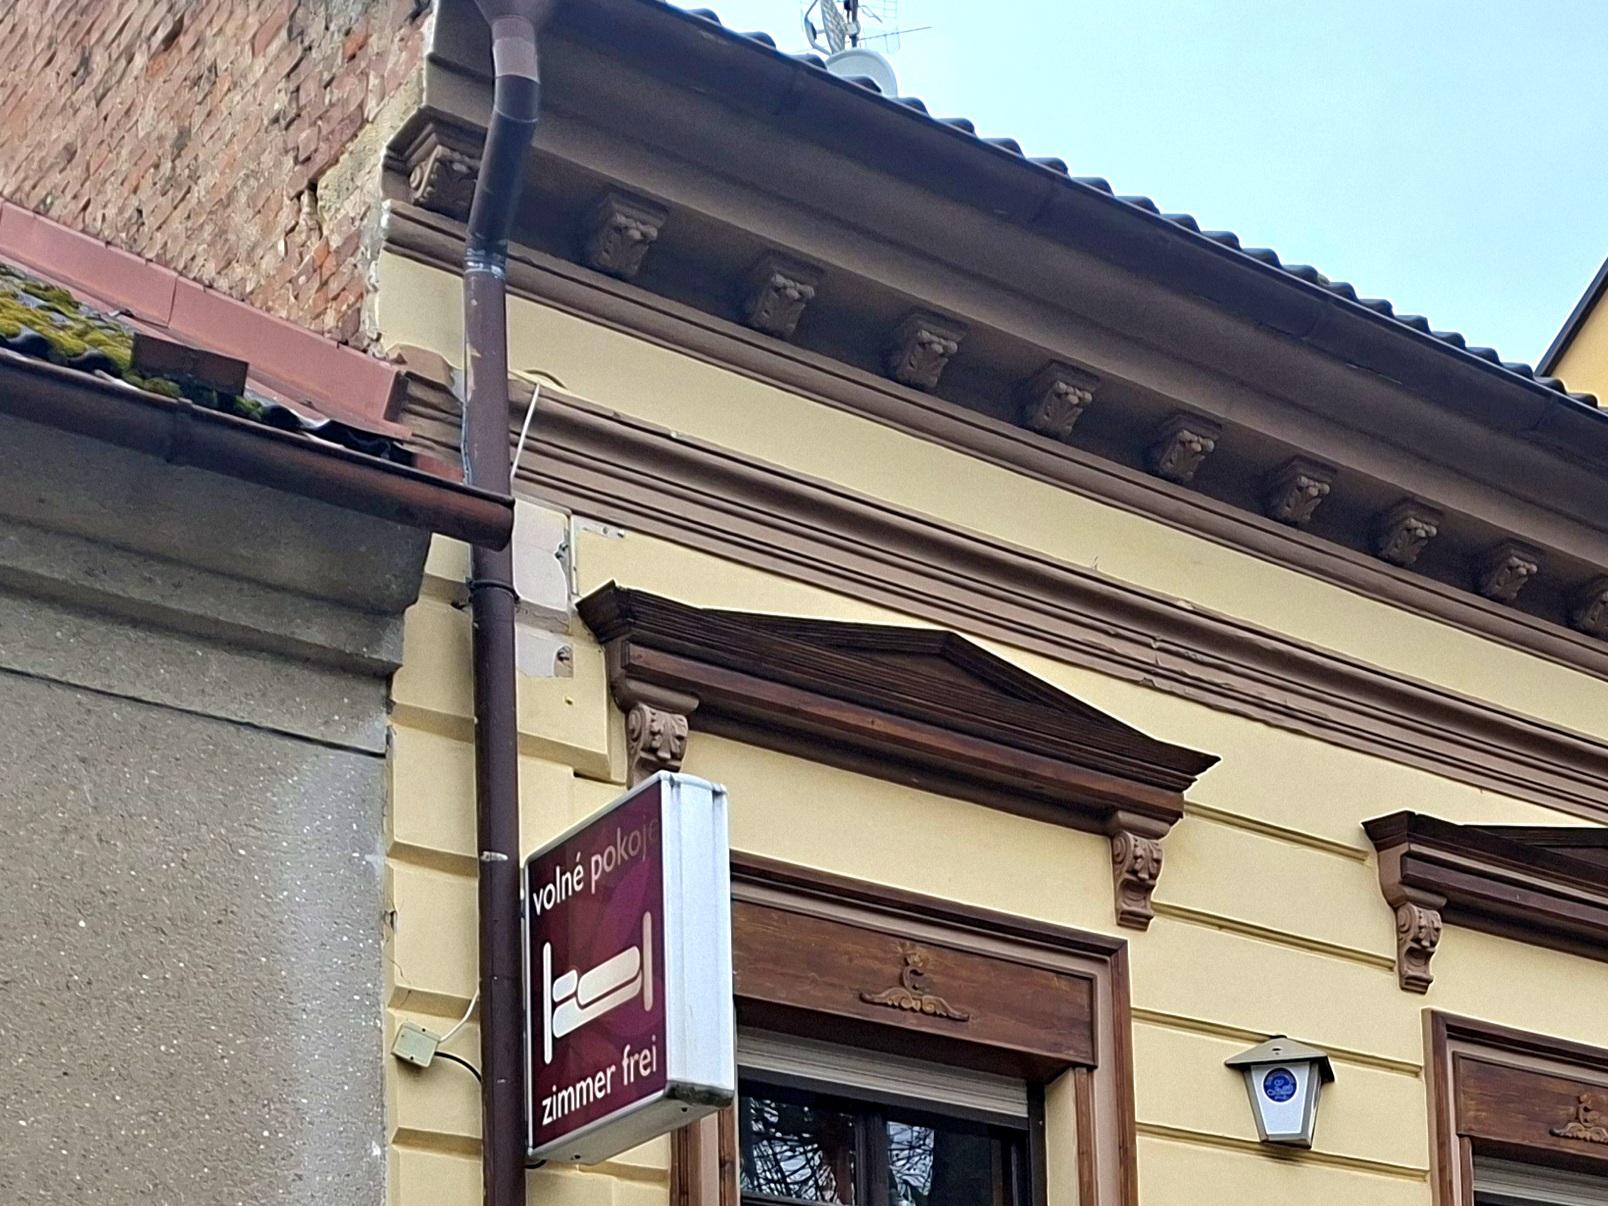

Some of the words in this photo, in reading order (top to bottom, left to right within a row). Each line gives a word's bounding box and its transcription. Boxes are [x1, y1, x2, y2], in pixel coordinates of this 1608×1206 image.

[533, 851, 584, 916] volné
[541, 1065, 616, 1126] zimmer
[621, 1034, 657, 1087] frei
